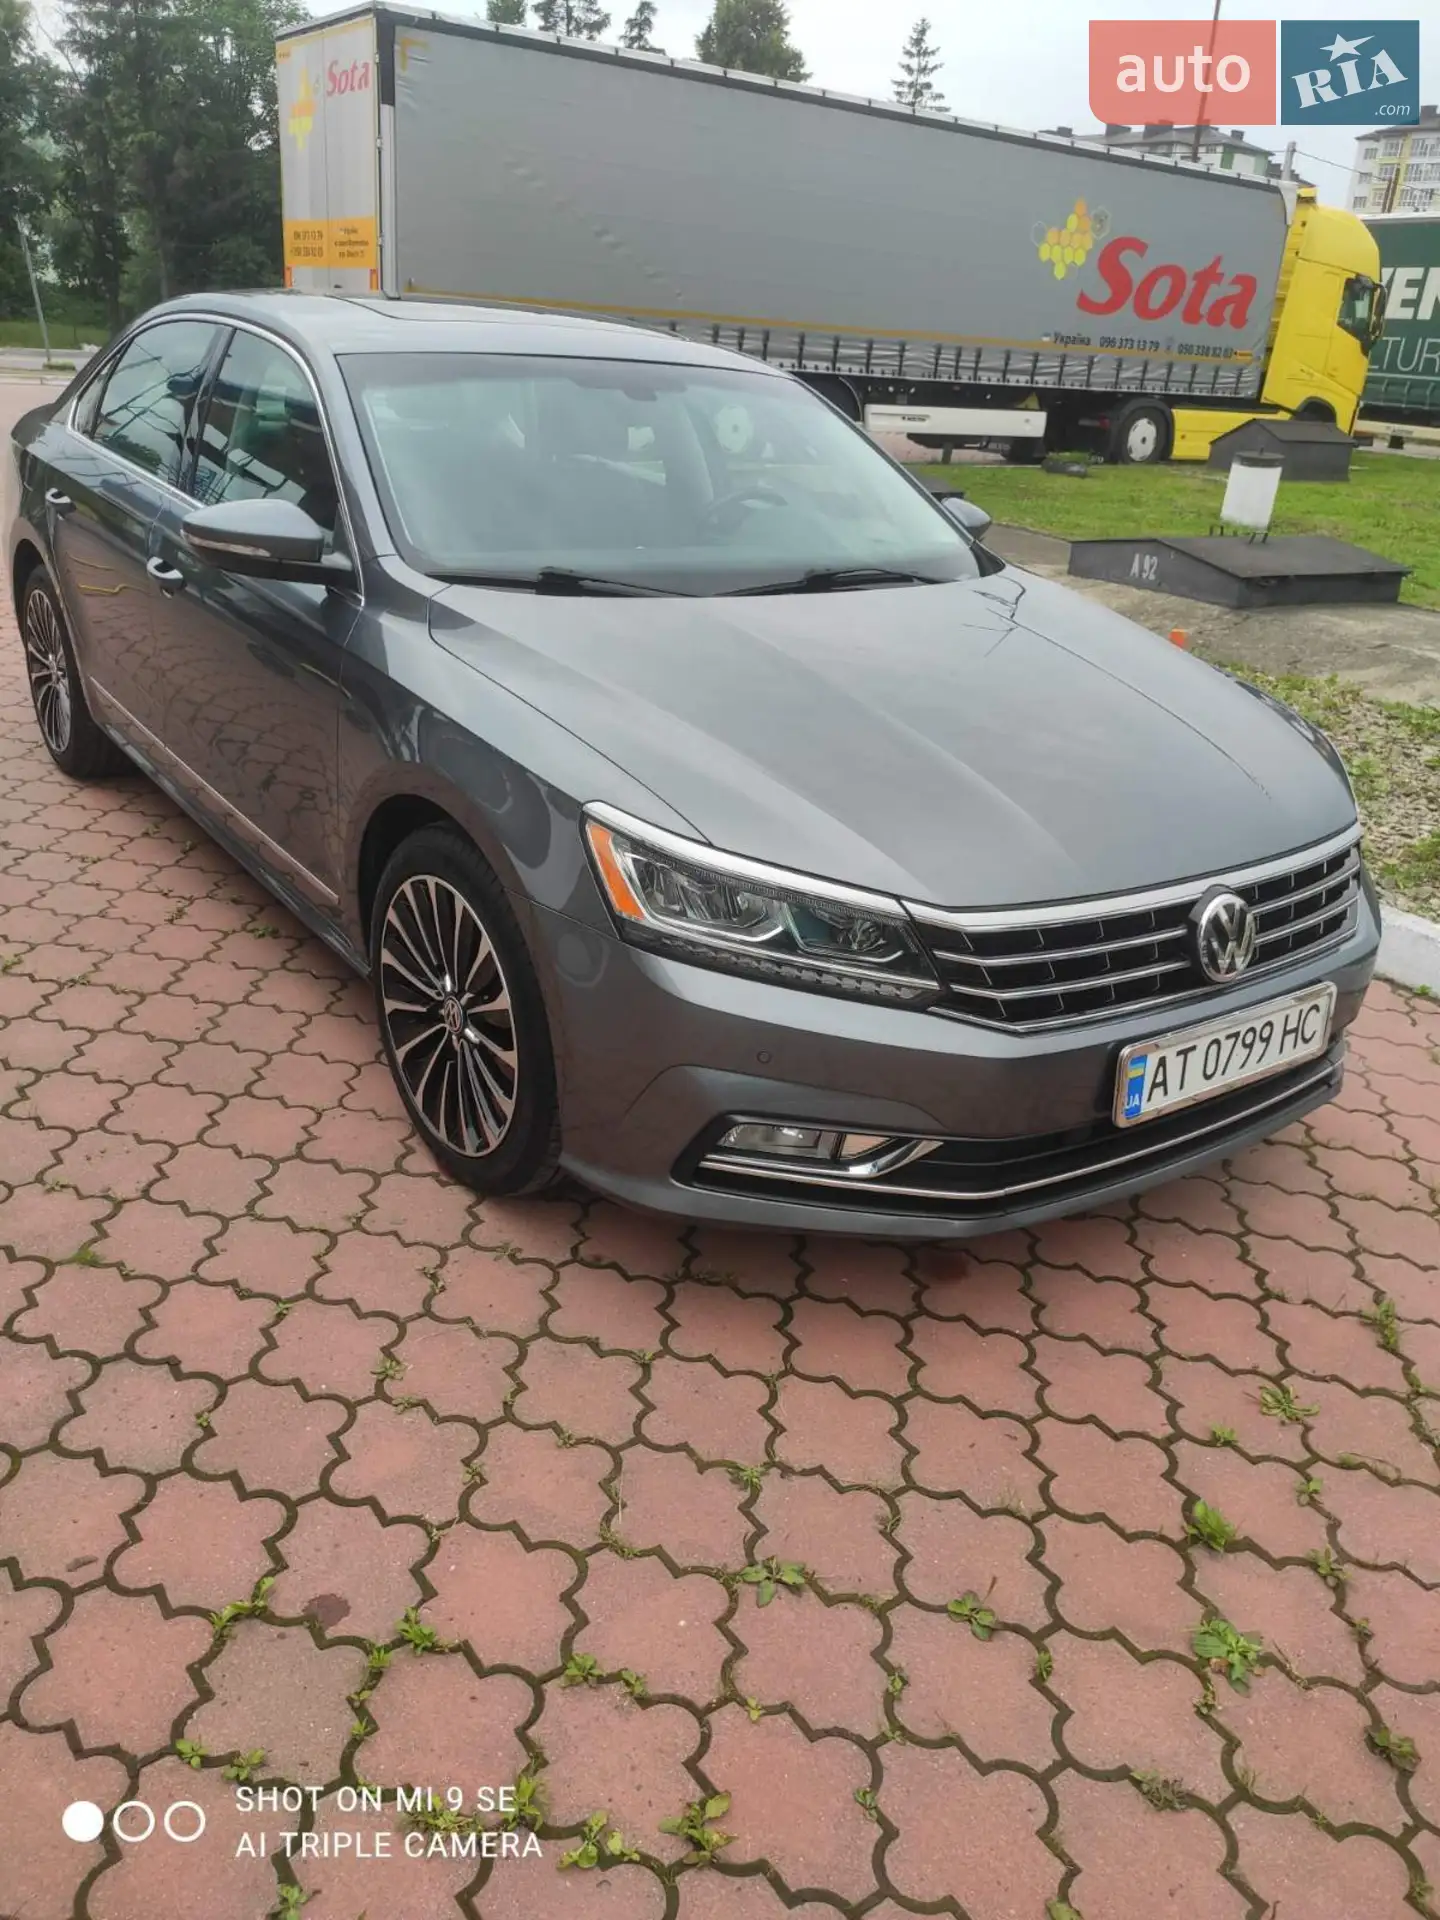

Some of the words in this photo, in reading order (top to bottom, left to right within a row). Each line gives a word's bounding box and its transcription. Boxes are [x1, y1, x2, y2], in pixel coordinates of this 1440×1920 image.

[326, 60, 370, 97] Sota
[1076, 236, 1257, 329] Sota
[1054, 331, 1092, 348] Україна
[1141, 555, 1158, 580] 92
[1146, 1045, 1197, 1103] AT
[1202, 1020, 1275, 1081] 0799
[1279, 1004, 1320, 1055] HC
